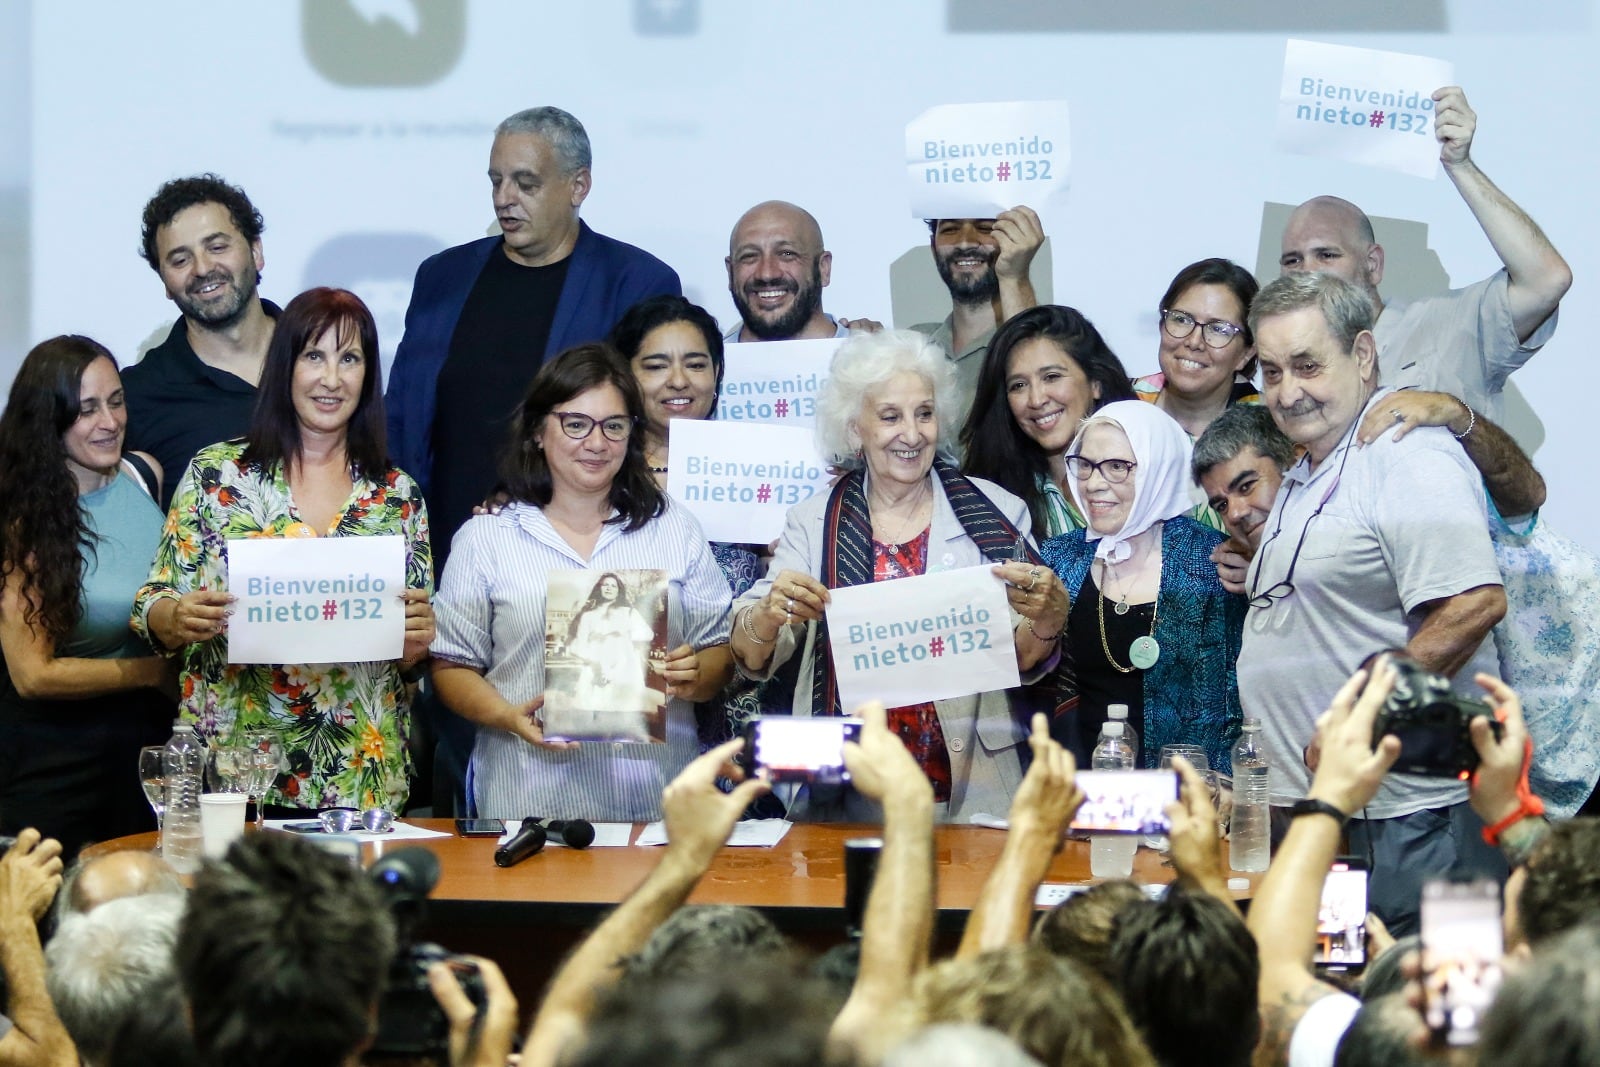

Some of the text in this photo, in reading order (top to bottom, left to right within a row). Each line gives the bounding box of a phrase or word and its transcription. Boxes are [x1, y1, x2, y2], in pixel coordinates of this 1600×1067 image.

[1300, 77, 1434, 111] Bienvenido
[1296, 101, 1428, 136] nieto#132
[924, 136, 1053, 159] Bienvenido
[925, 160, 1052, 183] nieto#132
[713, 397, 817, 420] ieto#13
[686, 456, 820, 481] Bienvenido
[248, 573, 386, 596] Bienvenido
[248, 598, 383, 623] nieto#132
[849, 604, 990, 644] Bienvenido
[853, 628, 992, 671] nieto#132
